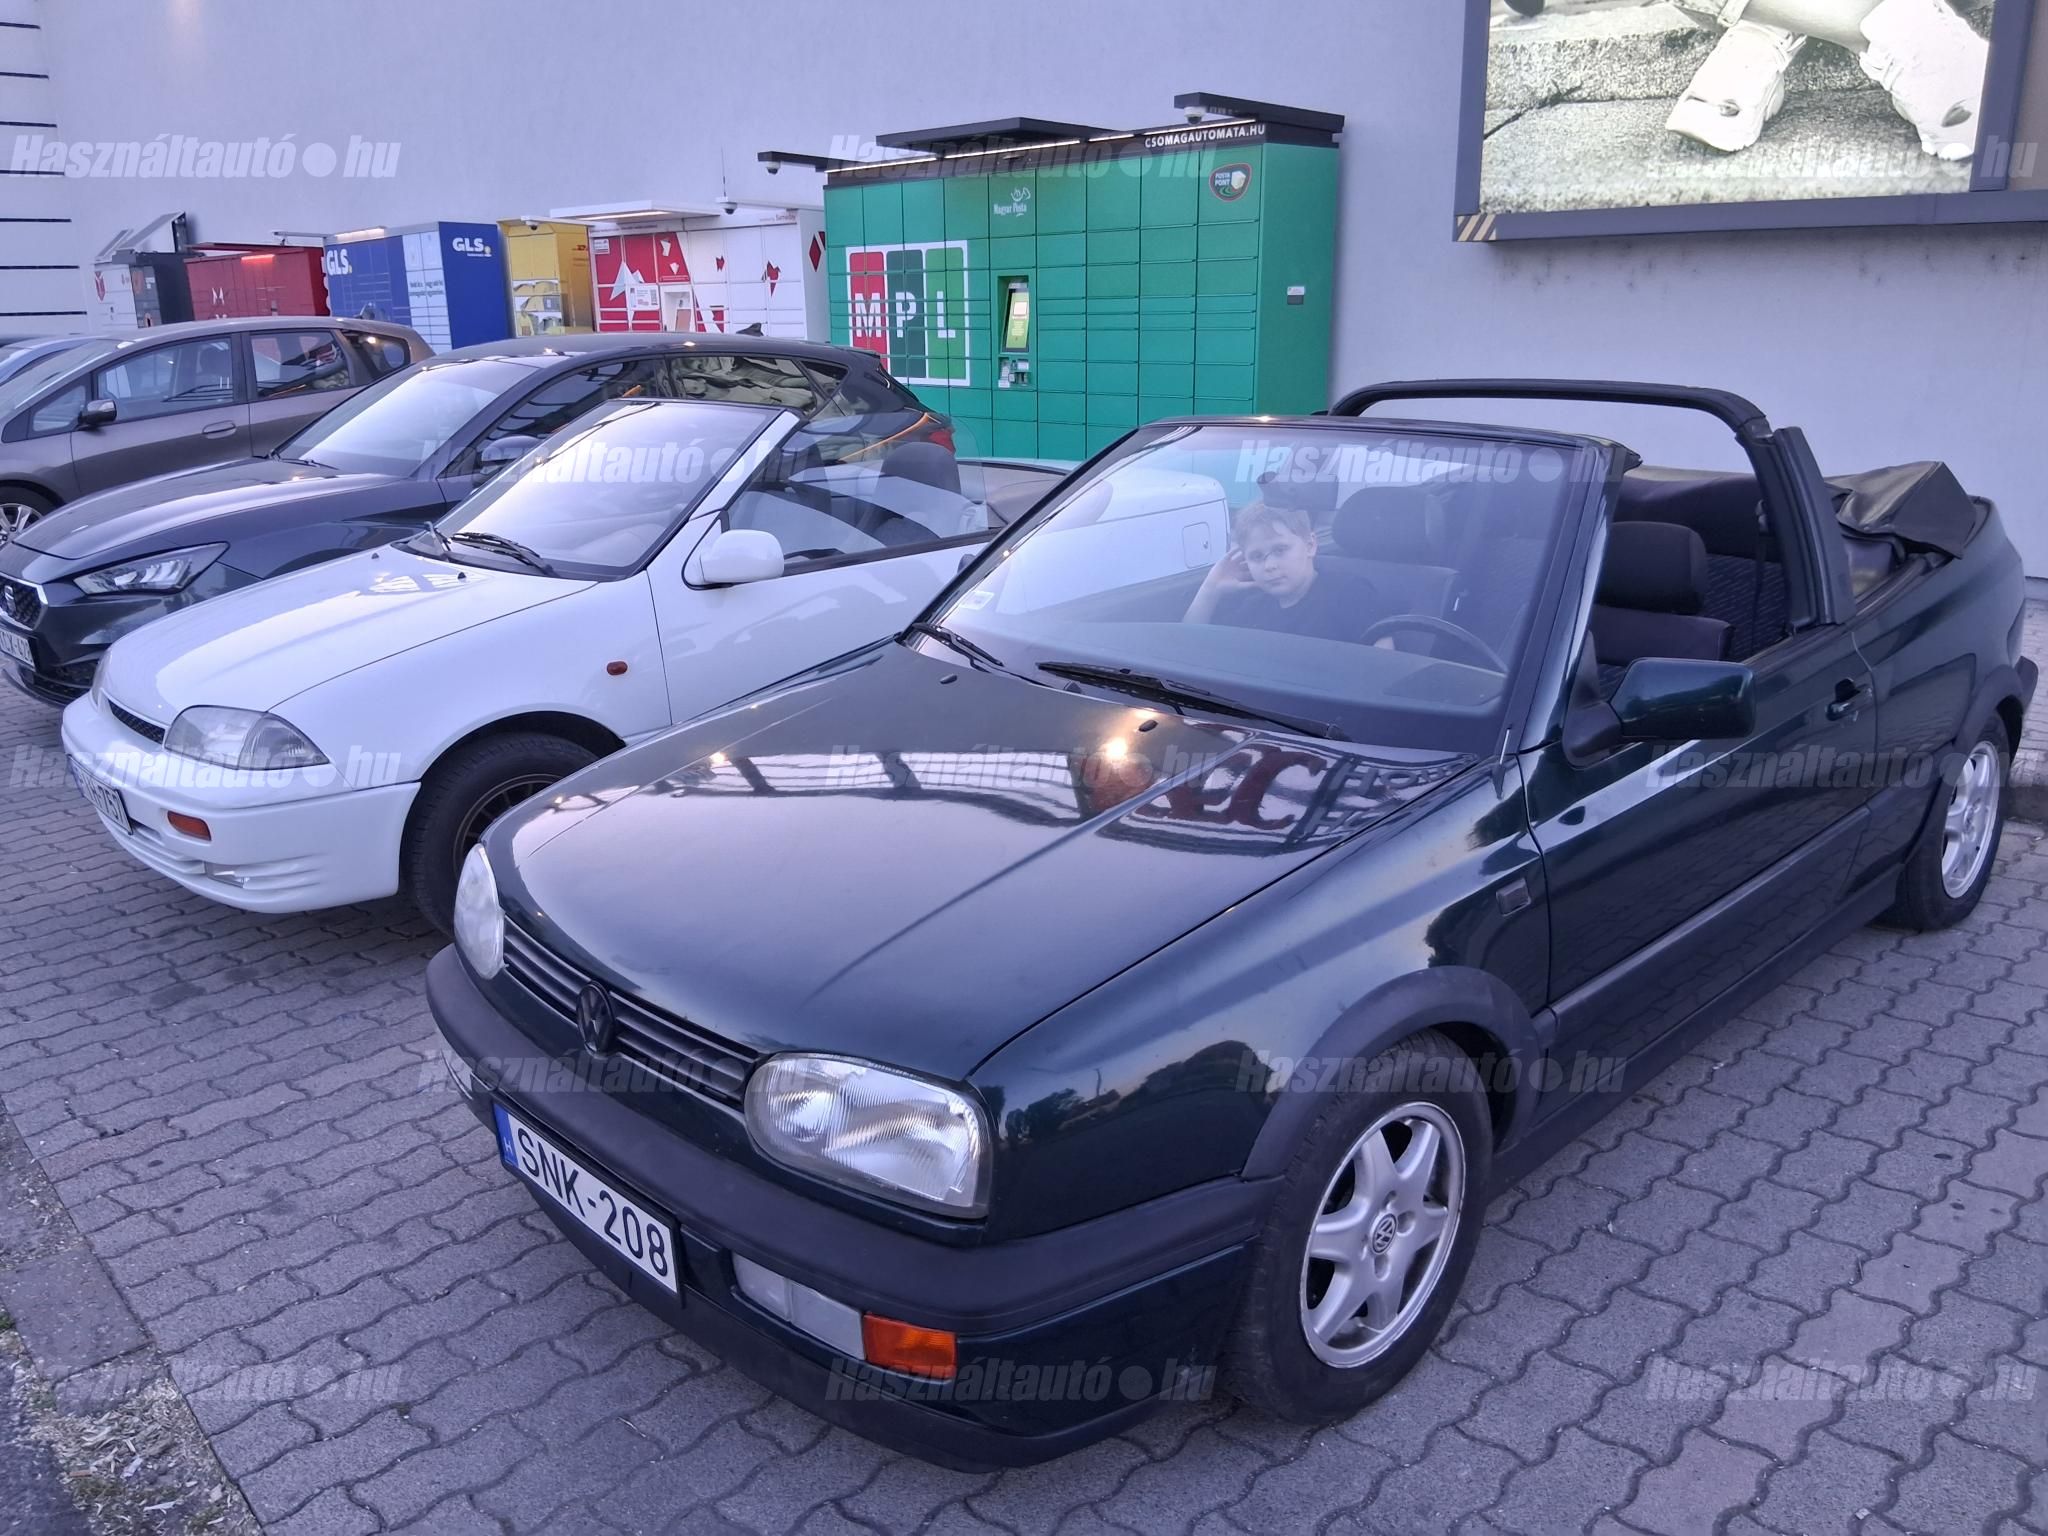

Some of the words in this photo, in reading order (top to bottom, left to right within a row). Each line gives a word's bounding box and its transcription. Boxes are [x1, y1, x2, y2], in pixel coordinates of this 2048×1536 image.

[1144, 124, 1266, 148] CSOMAGAUTOMATA.HU
[855, 291, 956, 338] MPL
[503, 1136, 513, 1153] H
[517, 1127, 668, 1277] SNK-208
